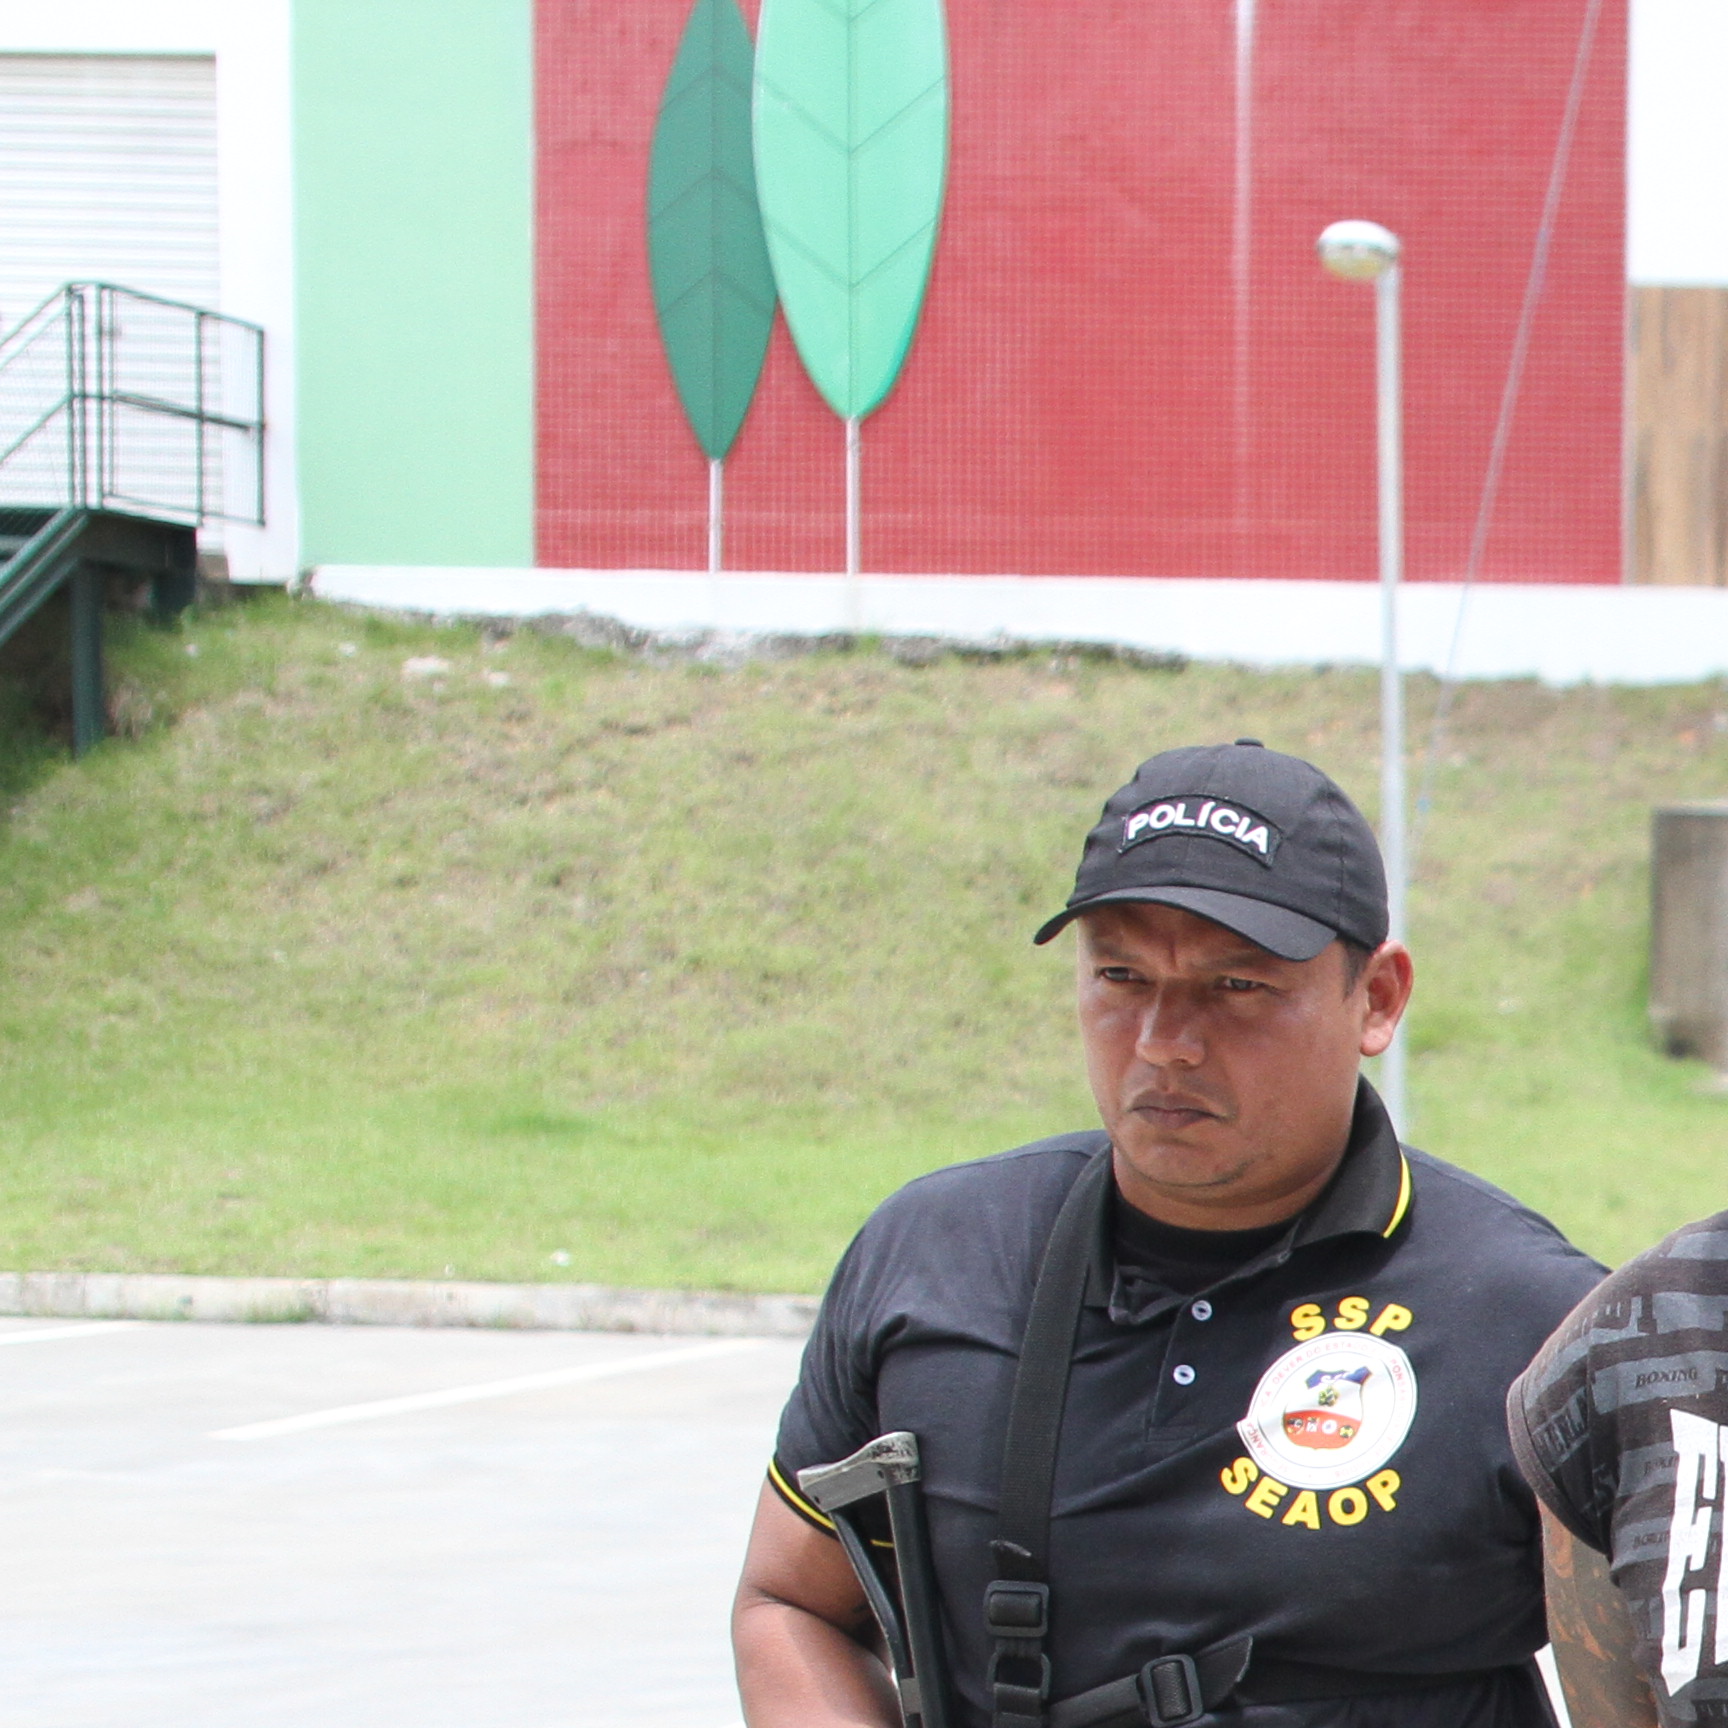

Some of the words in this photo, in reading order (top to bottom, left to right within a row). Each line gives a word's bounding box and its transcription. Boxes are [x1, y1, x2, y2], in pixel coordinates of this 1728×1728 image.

[1127, 800, 1271, 855] POLÍCIA
[1290, 1296, 1413, 1341] SSP
[1220, 1456, 1401, 1530] SEAOP
